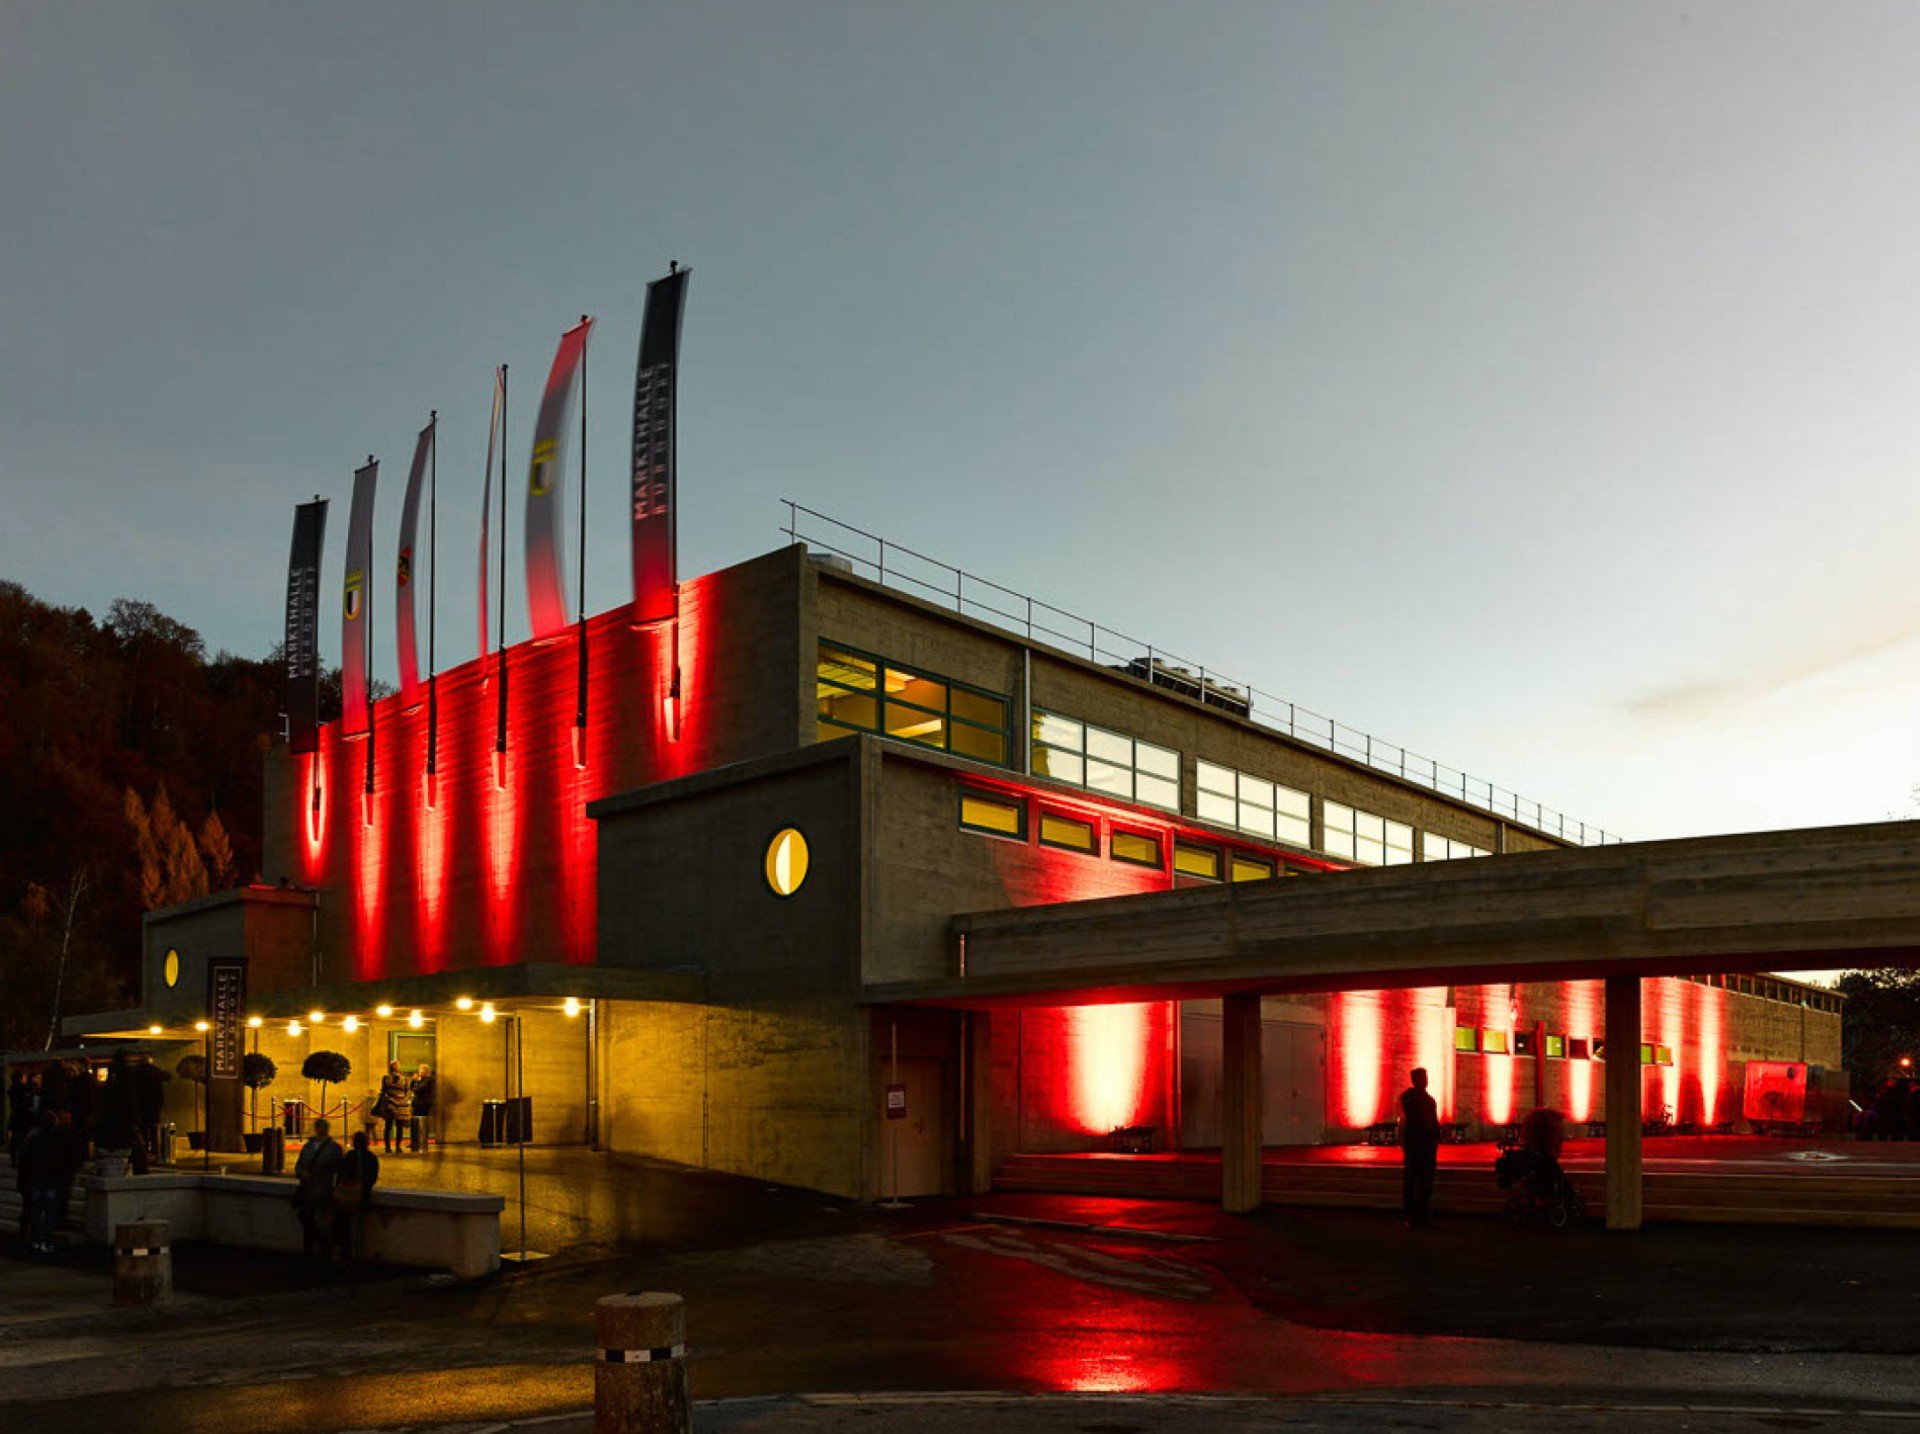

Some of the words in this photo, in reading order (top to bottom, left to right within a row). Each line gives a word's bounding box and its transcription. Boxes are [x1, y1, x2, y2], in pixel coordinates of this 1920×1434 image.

[634, 366, 653, 520] MARKTHALLE
[288, 568, 301, 678] MARKTHALLE
[216, 974, 227, 1071] MARKTHALLE
